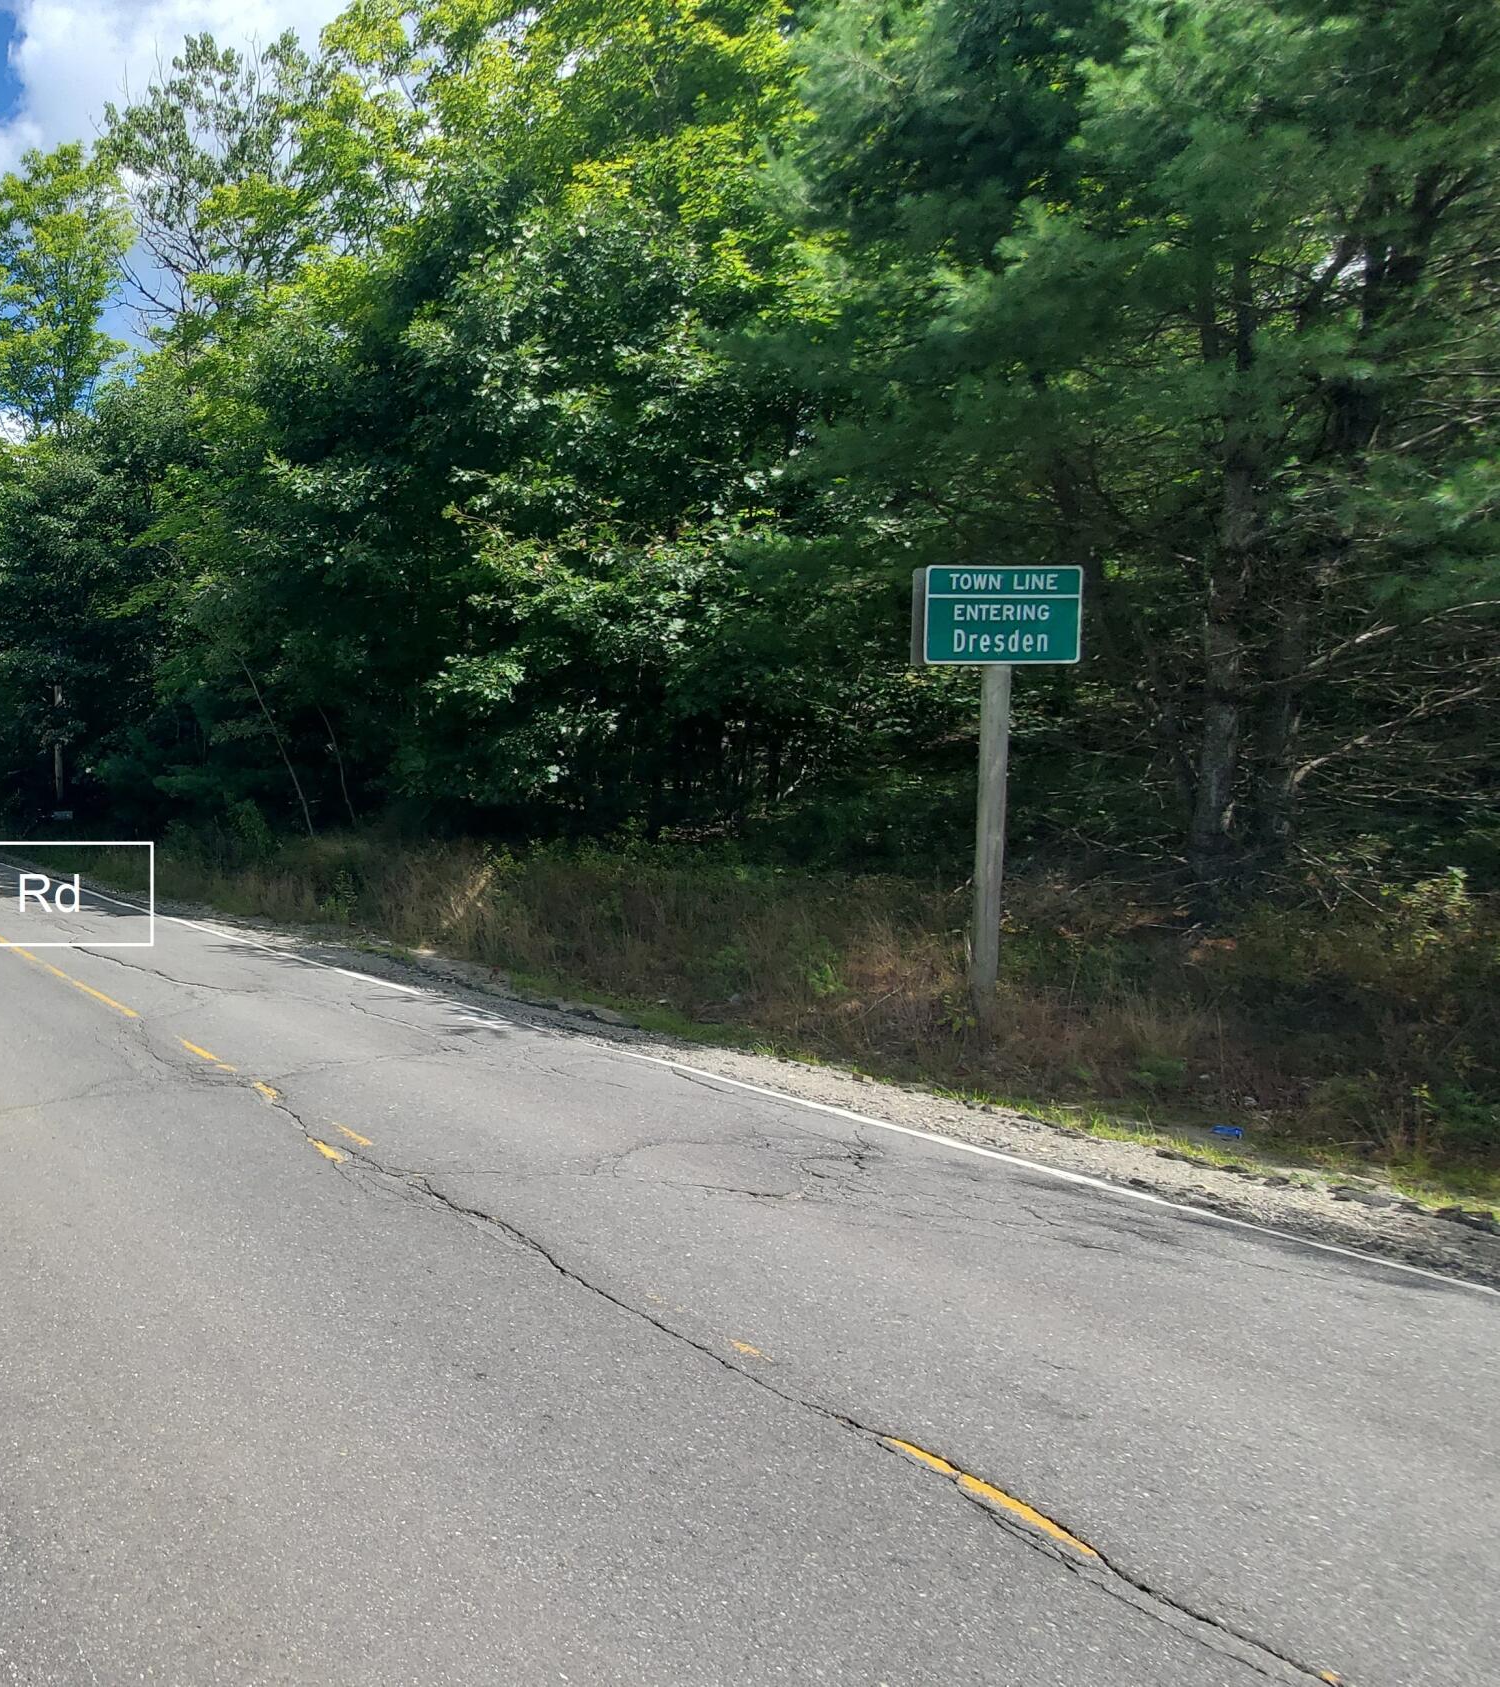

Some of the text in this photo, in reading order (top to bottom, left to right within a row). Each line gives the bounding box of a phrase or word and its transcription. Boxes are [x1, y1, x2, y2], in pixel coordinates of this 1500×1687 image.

[950, 573, 1058, 591] TOWN LINE
[953, 604, 1051, 622] ENTERING
[953, 628, 1049, 653] Dresden
